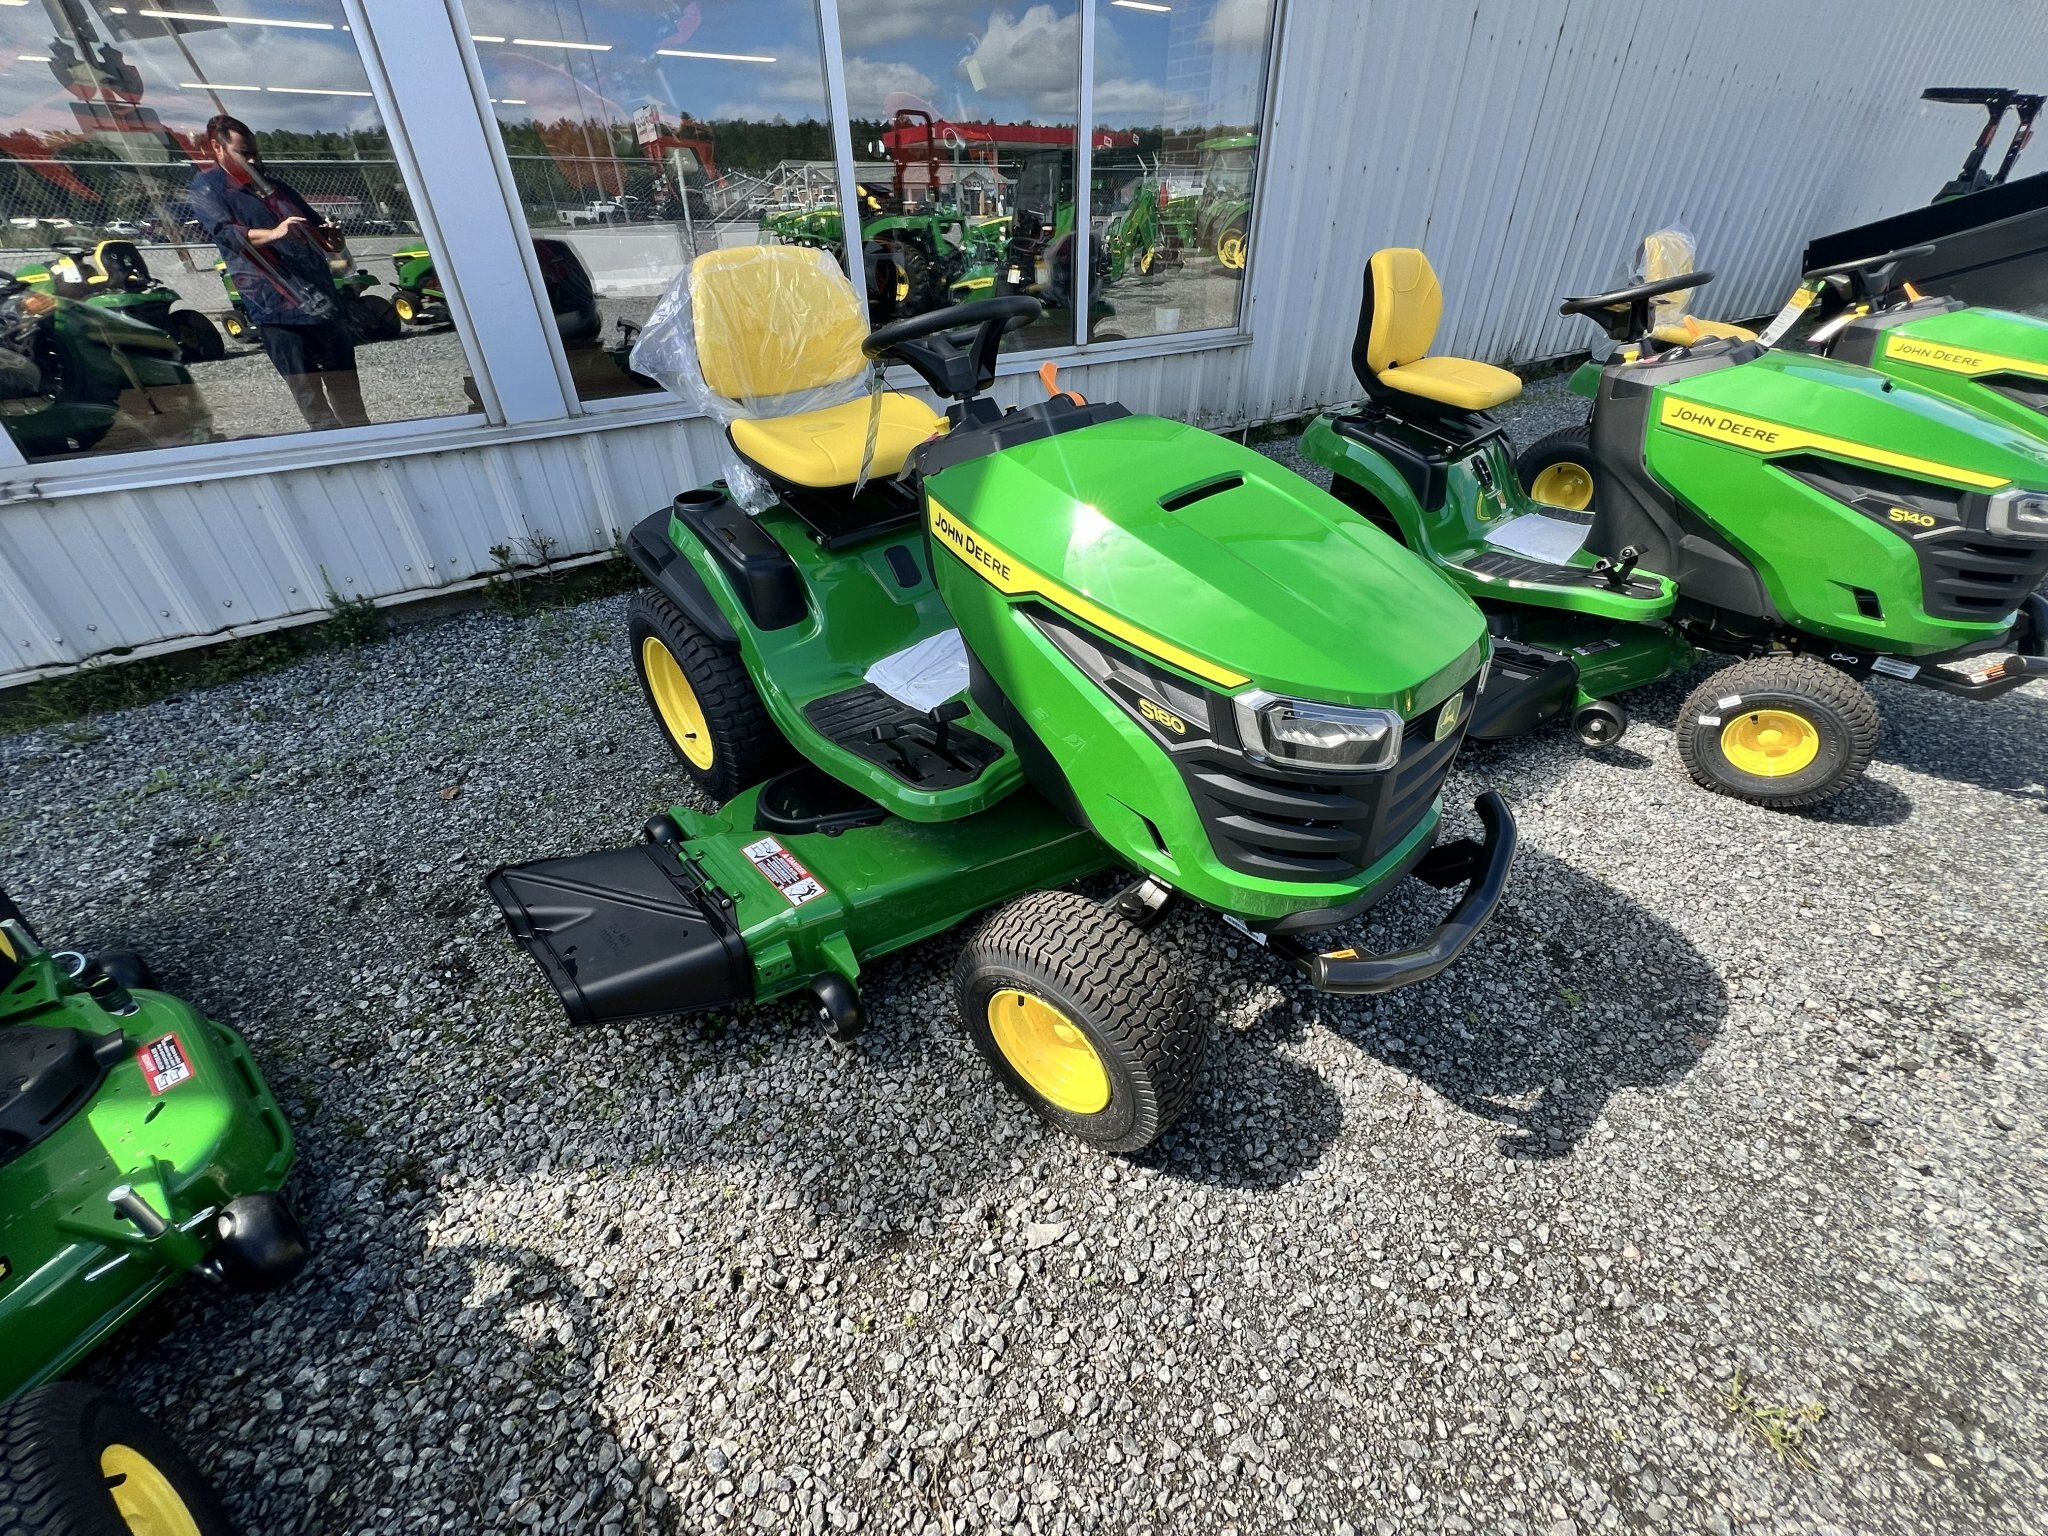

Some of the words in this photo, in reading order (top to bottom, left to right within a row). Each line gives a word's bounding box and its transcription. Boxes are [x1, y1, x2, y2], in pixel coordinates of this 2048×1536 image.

[1894, 344, 1932, 357] JOHN
[1933, 350, 1982, 367] DEERE
[1671, 407, 1716, 428] JOHN
[1718, 418, 1779, 443] DEERE
[1889, 508, 1935, 527] S140
[935, 512, 964, 547] JOHN
[966, 535, 1011, 581] DEERE
[1138, 698, 1186, 735] S180
